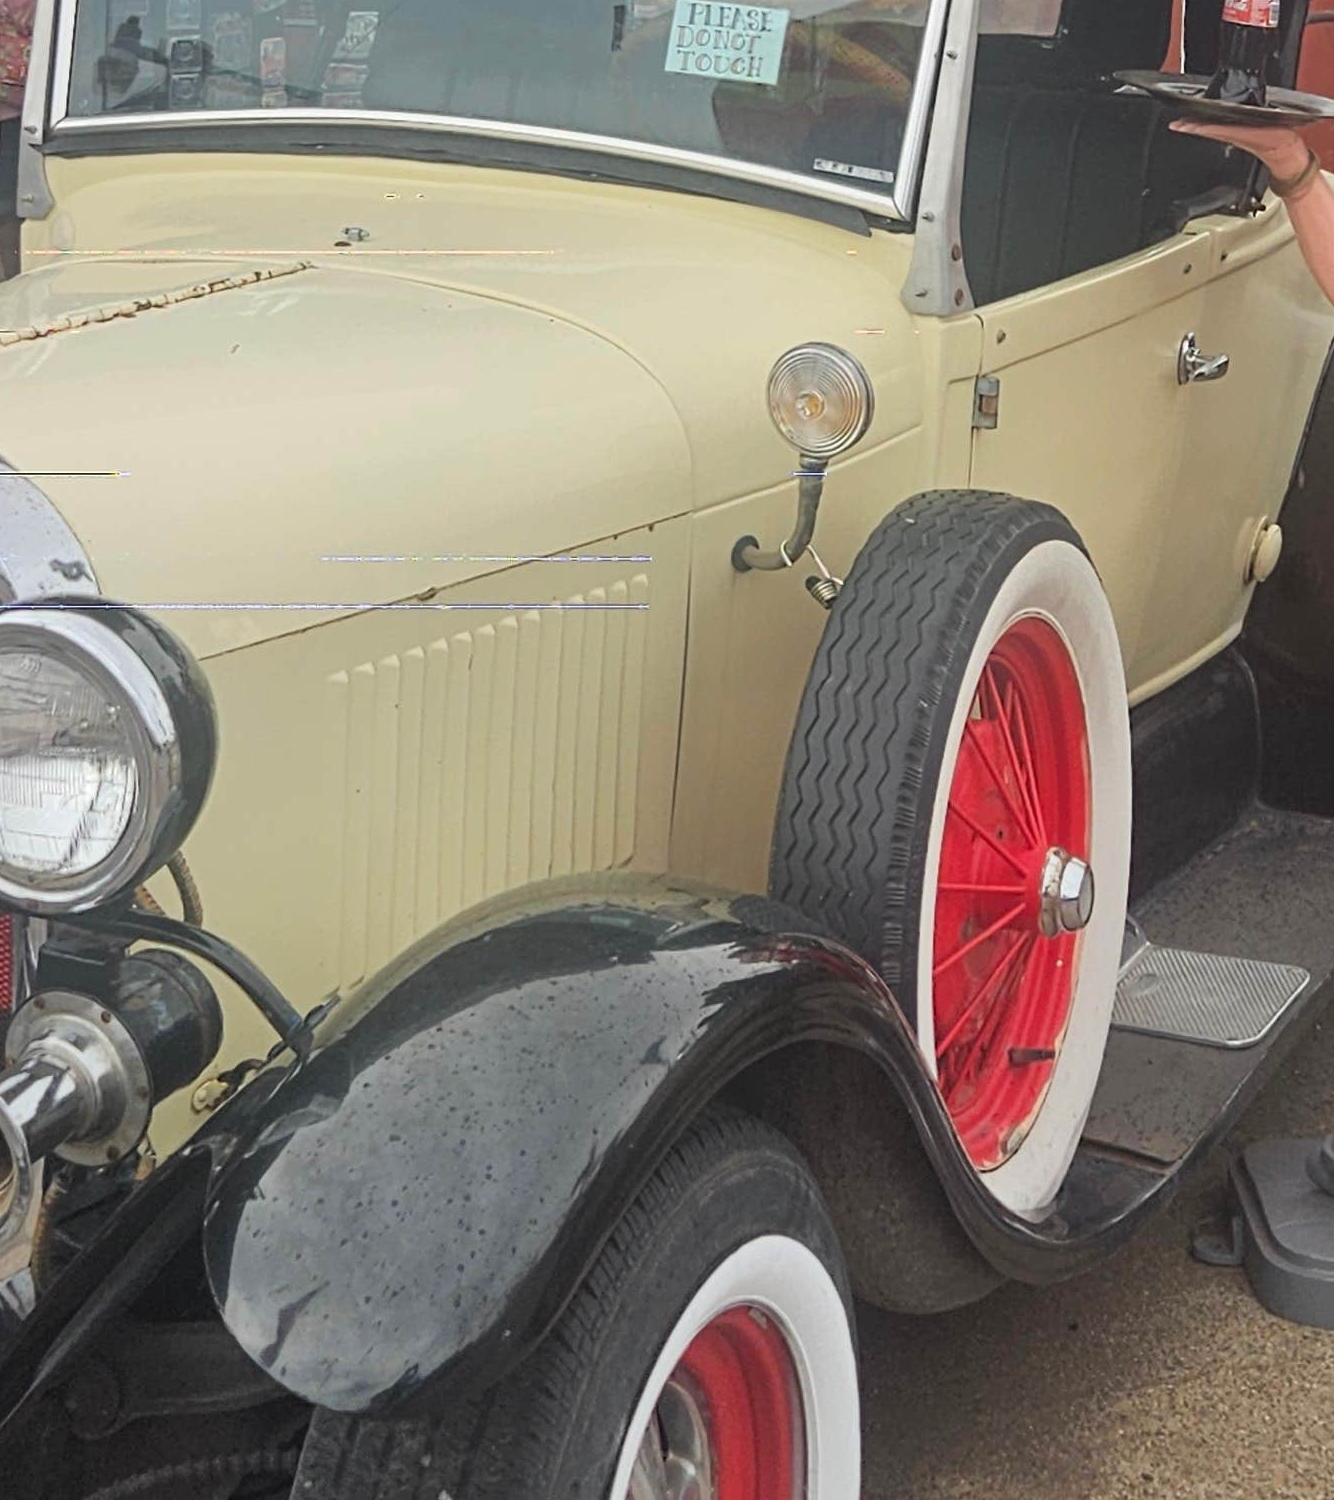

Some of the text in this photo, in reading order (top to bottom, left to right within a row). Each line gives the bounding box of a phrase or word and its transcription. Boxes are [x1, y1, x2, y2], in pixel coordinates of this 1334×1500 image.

[688, 2, 772, 32] PLEASE
[676, 25, 762, 54] DO NOT
[676, 49, 763, 77] TOUCH
